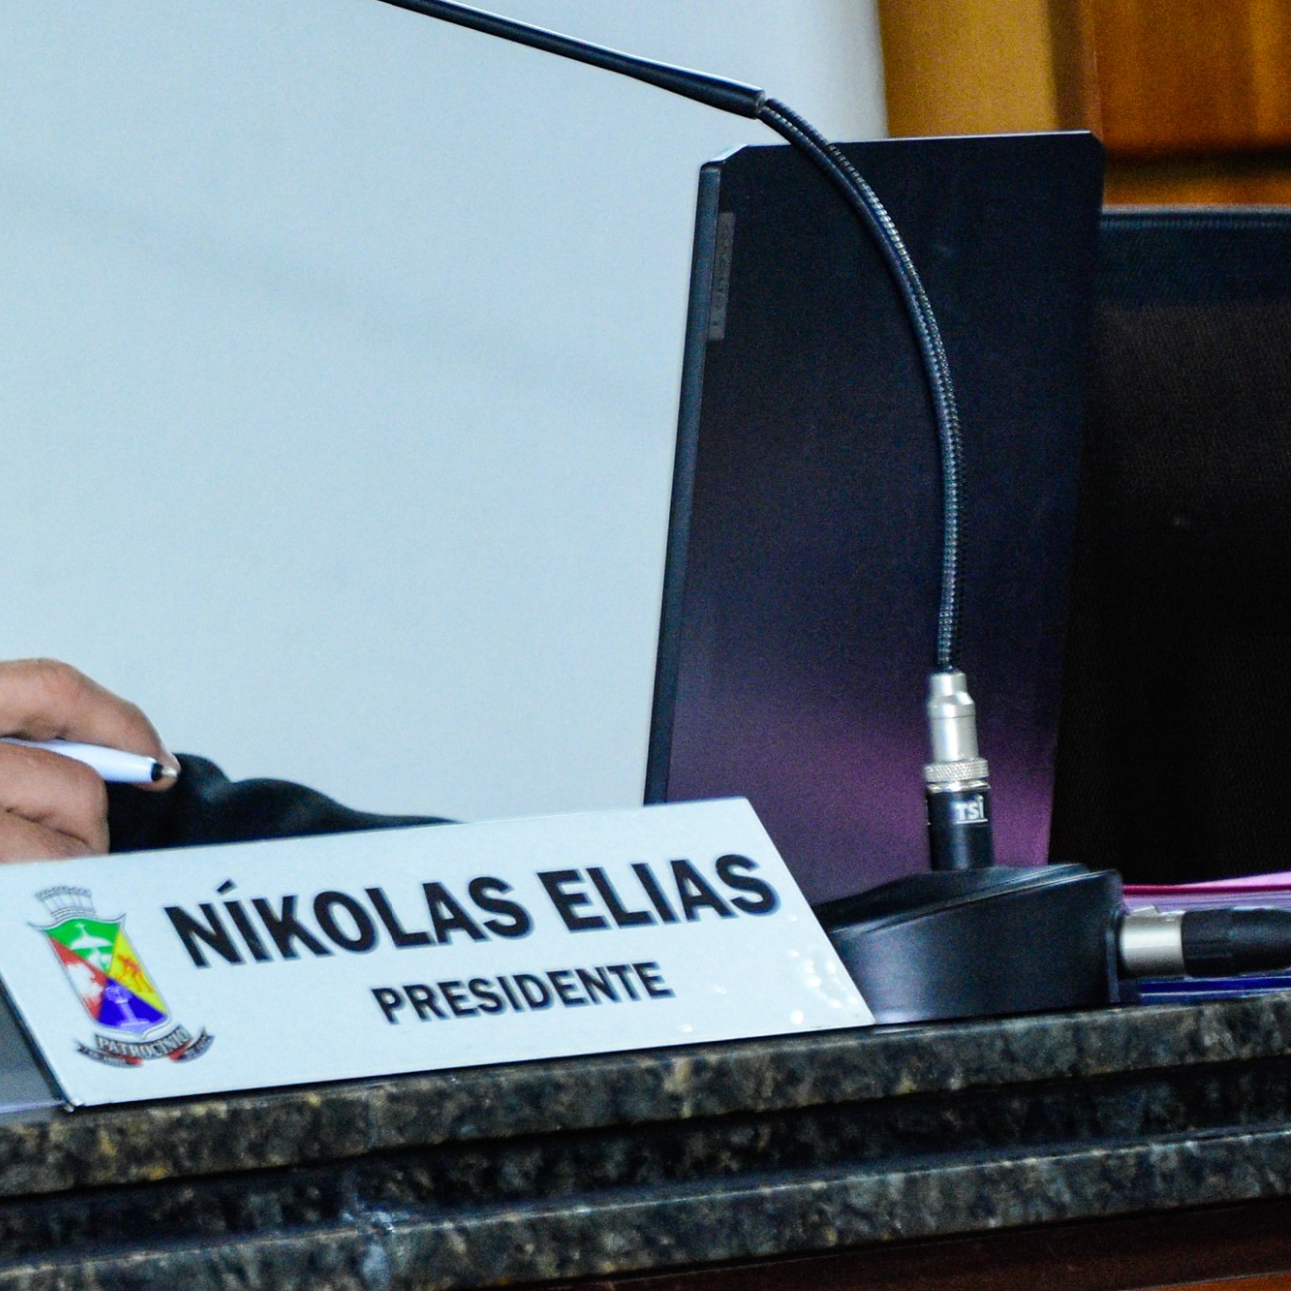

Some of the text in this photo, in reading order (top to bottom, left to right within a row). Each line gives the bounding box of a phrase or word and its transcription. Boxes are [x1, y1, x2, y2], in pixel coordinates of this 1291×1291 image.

[163, 853, 782, 969] NÍKOLAS ELIAS
[370, 961, 677, 1024] PRESIDENTE
